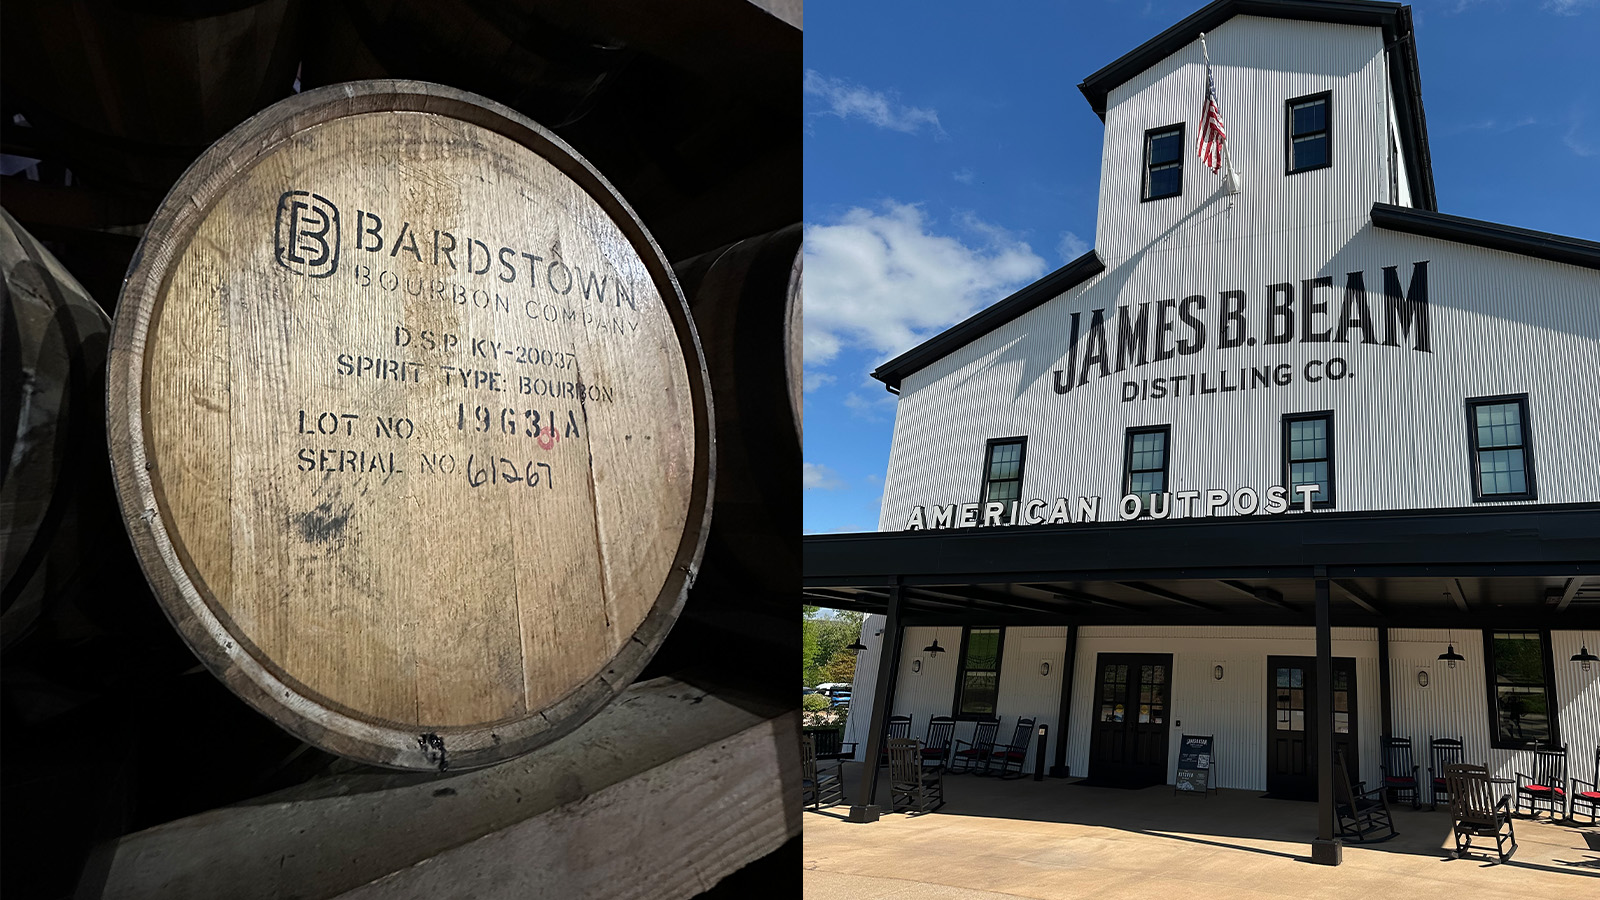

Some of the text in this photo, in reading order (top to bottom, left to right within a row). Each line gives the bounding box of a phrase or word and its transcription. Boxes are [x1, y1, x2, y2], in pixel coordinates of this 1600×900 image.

[355, 209, 637, 311] BARDSTOWN
[354, 264, 639, 335] BOURBON COMPANY
[1053, 260, 1432, 395] JAMES B. BEAM
[471, 338, 577, 370] KY-20037
[337, 353, 614, 403] SPIRIT TYPE: BOURBON
[1121, 357, 1355, 403] DISTILLING CO.
[298, 410, 359, 436] LOT
[457, 403, 580, 439] 19G31A
[298, 448, 403, 474] SERIAL
[467, 454, 553, 490] 61267
[905, 484, 1321, 532] AMERICAN OUTPOST
